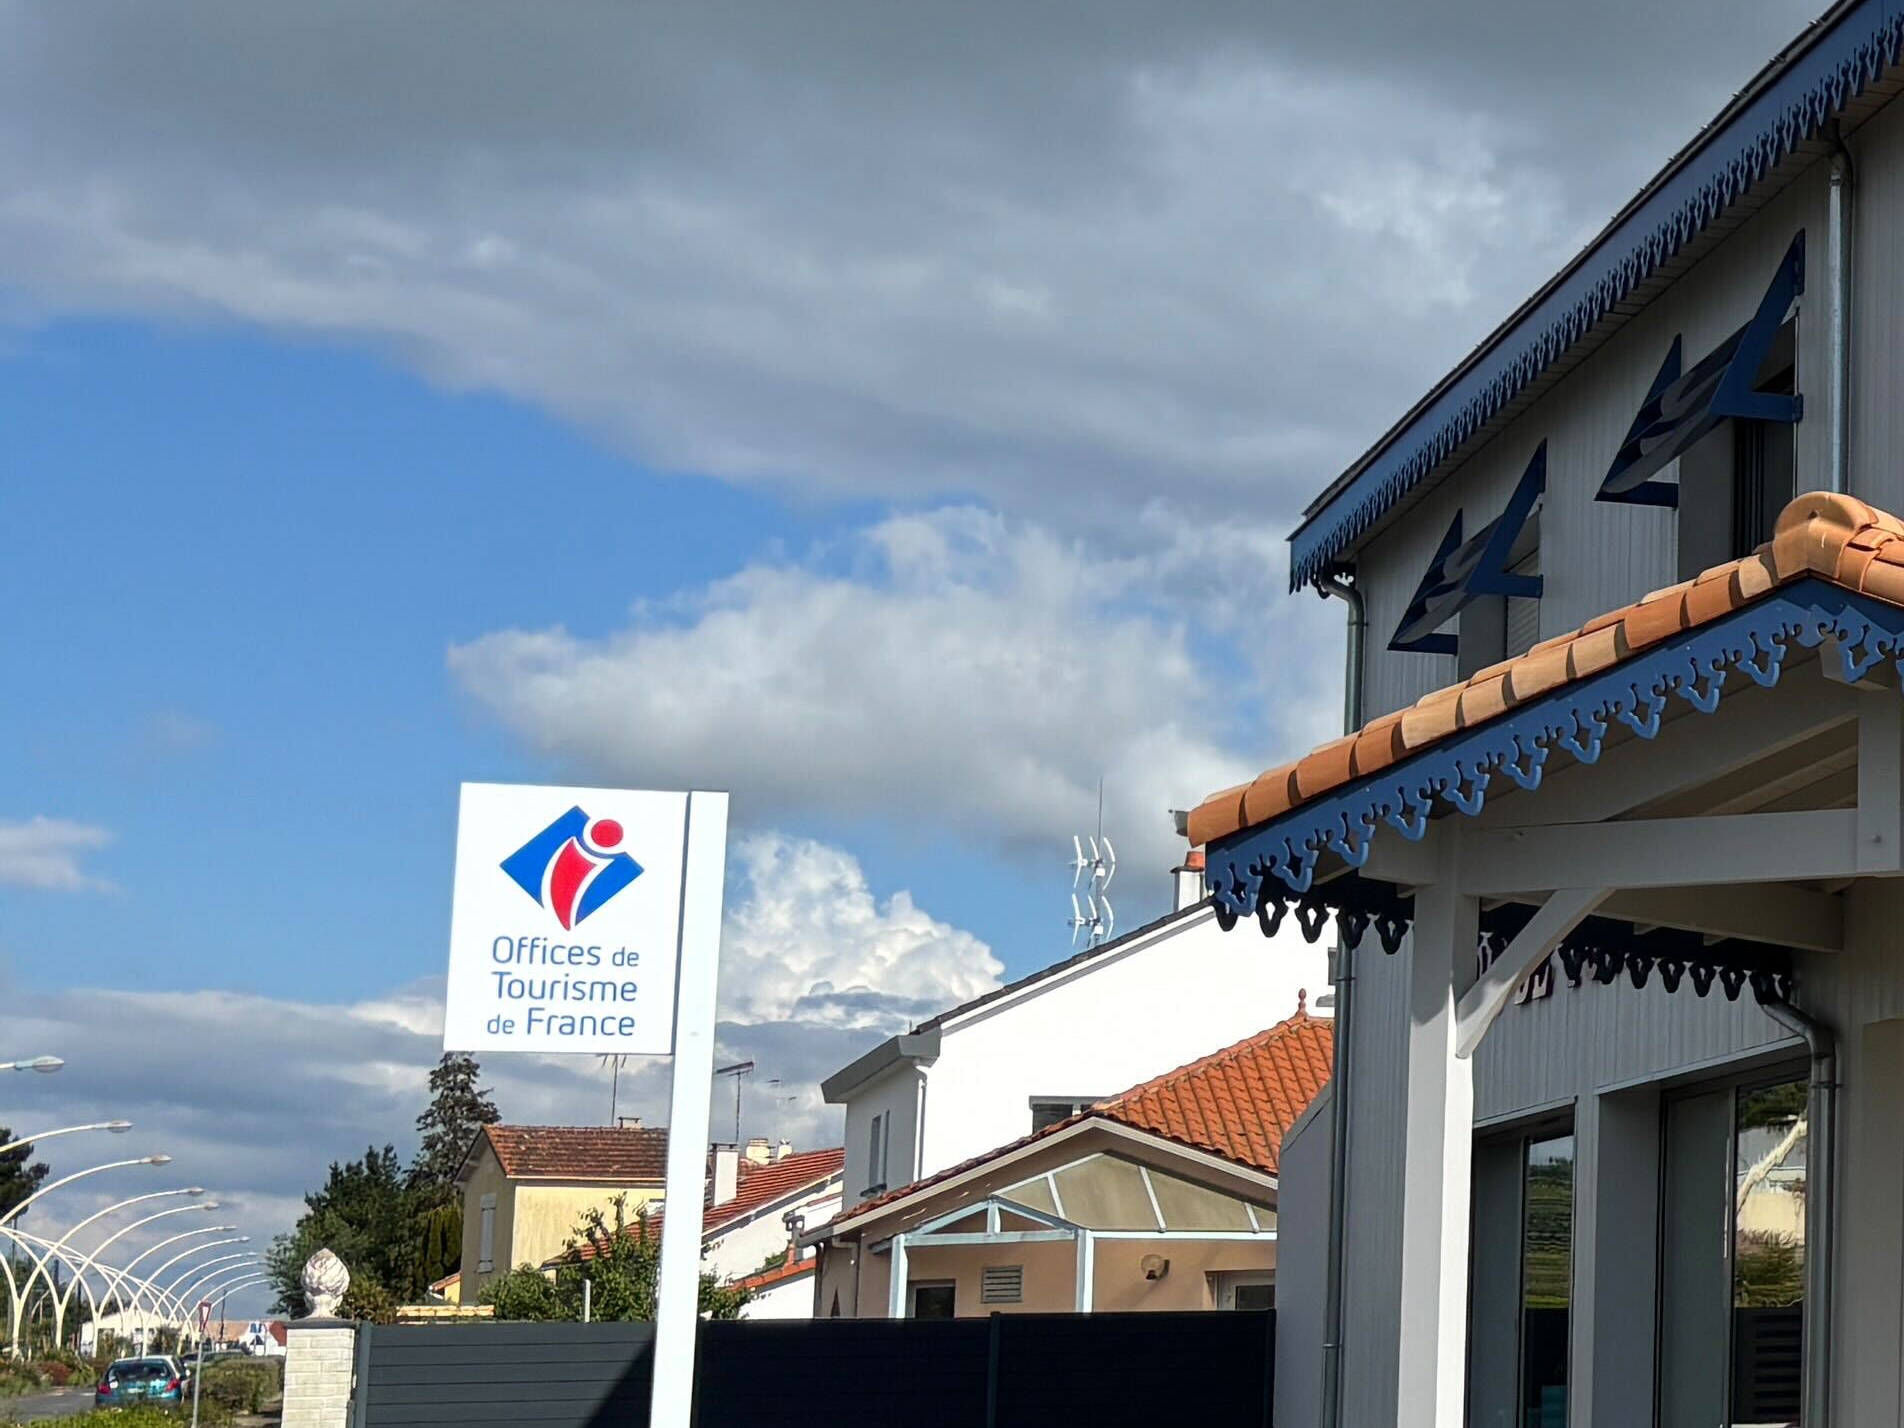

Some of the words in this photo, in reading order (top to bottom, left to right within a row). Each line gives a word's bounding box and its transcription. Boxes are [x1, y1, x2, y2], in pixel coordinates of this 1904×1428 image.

[492, 935, 601, 967] Offices
[611, 946, 640, 967] de
[491, 971, 638, 1003] Tourisme
[486, 1014, 515, 1035] de
[526, 1006, 636, 1037] France
